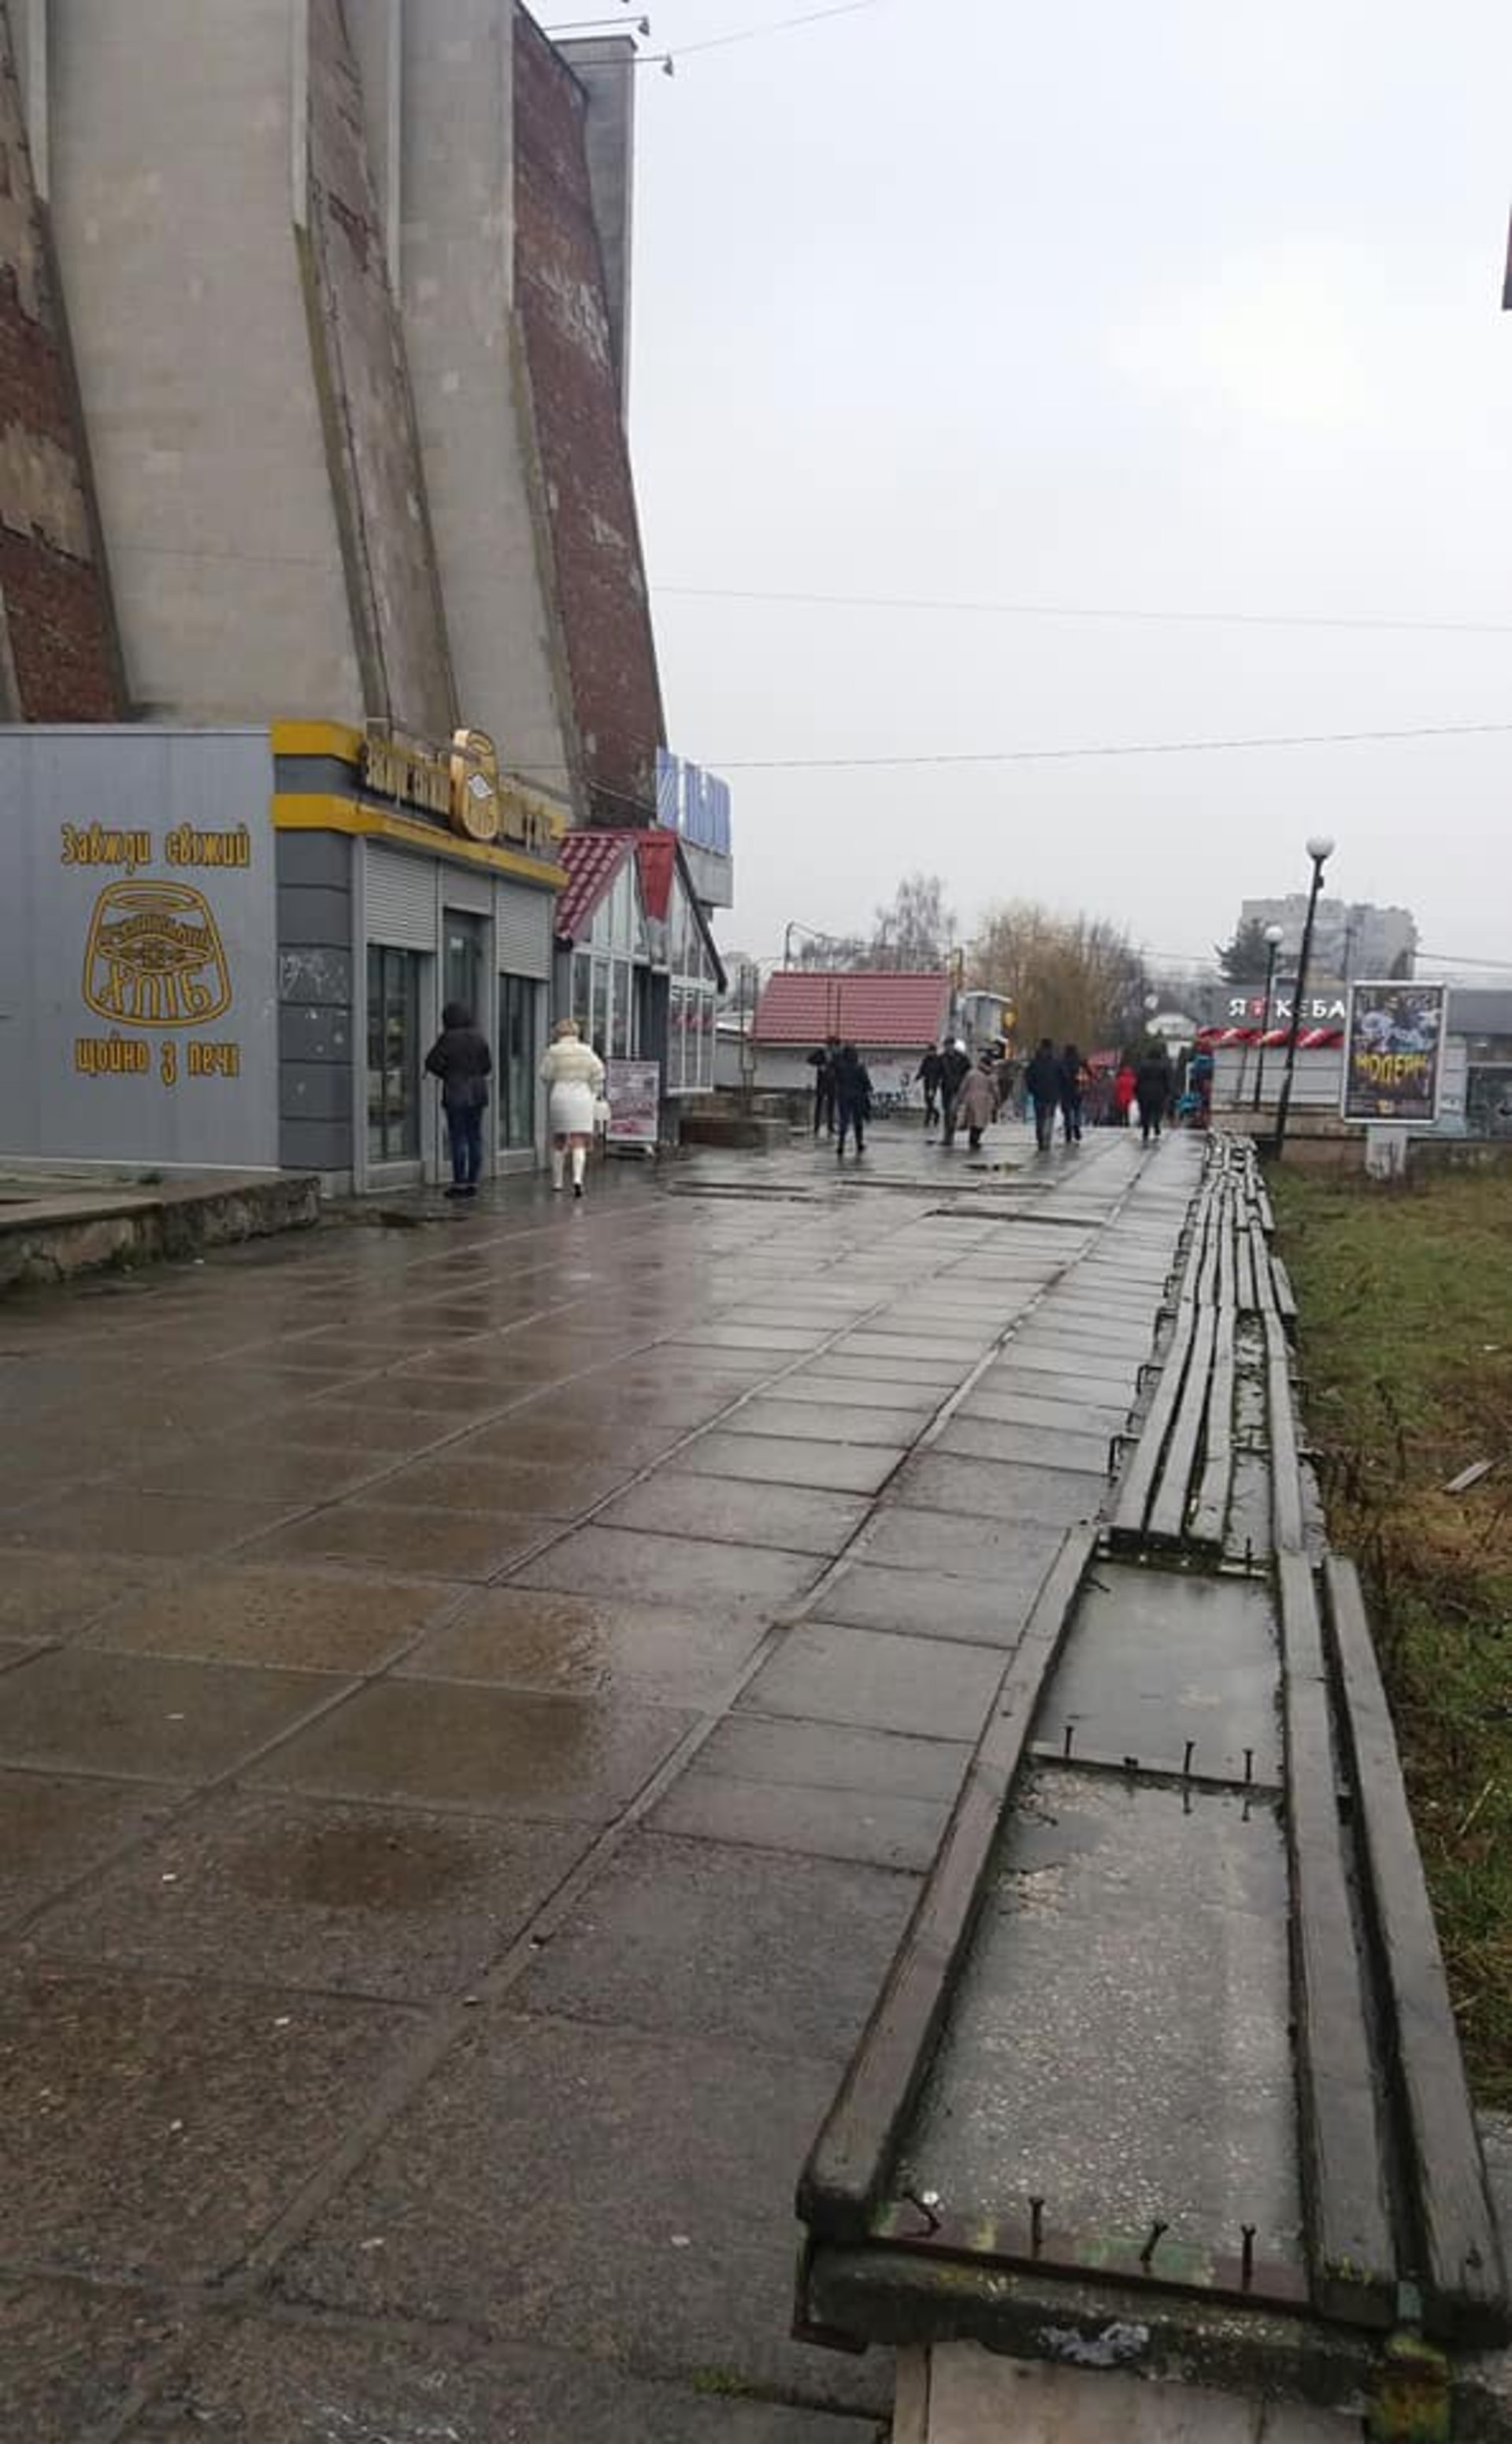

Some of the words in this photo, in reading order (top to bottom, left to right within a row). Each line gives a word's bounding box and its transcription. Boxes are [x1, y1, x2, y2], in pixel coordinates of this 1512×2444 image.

[61, 821, 151, 873] Завжди
[165, 821, 250, 866] свіжий
[1228, 997, 1246, 1017] Я
[75, 1029, 150, 1076] щойно
[188, 1041, 239, 1077] печі
